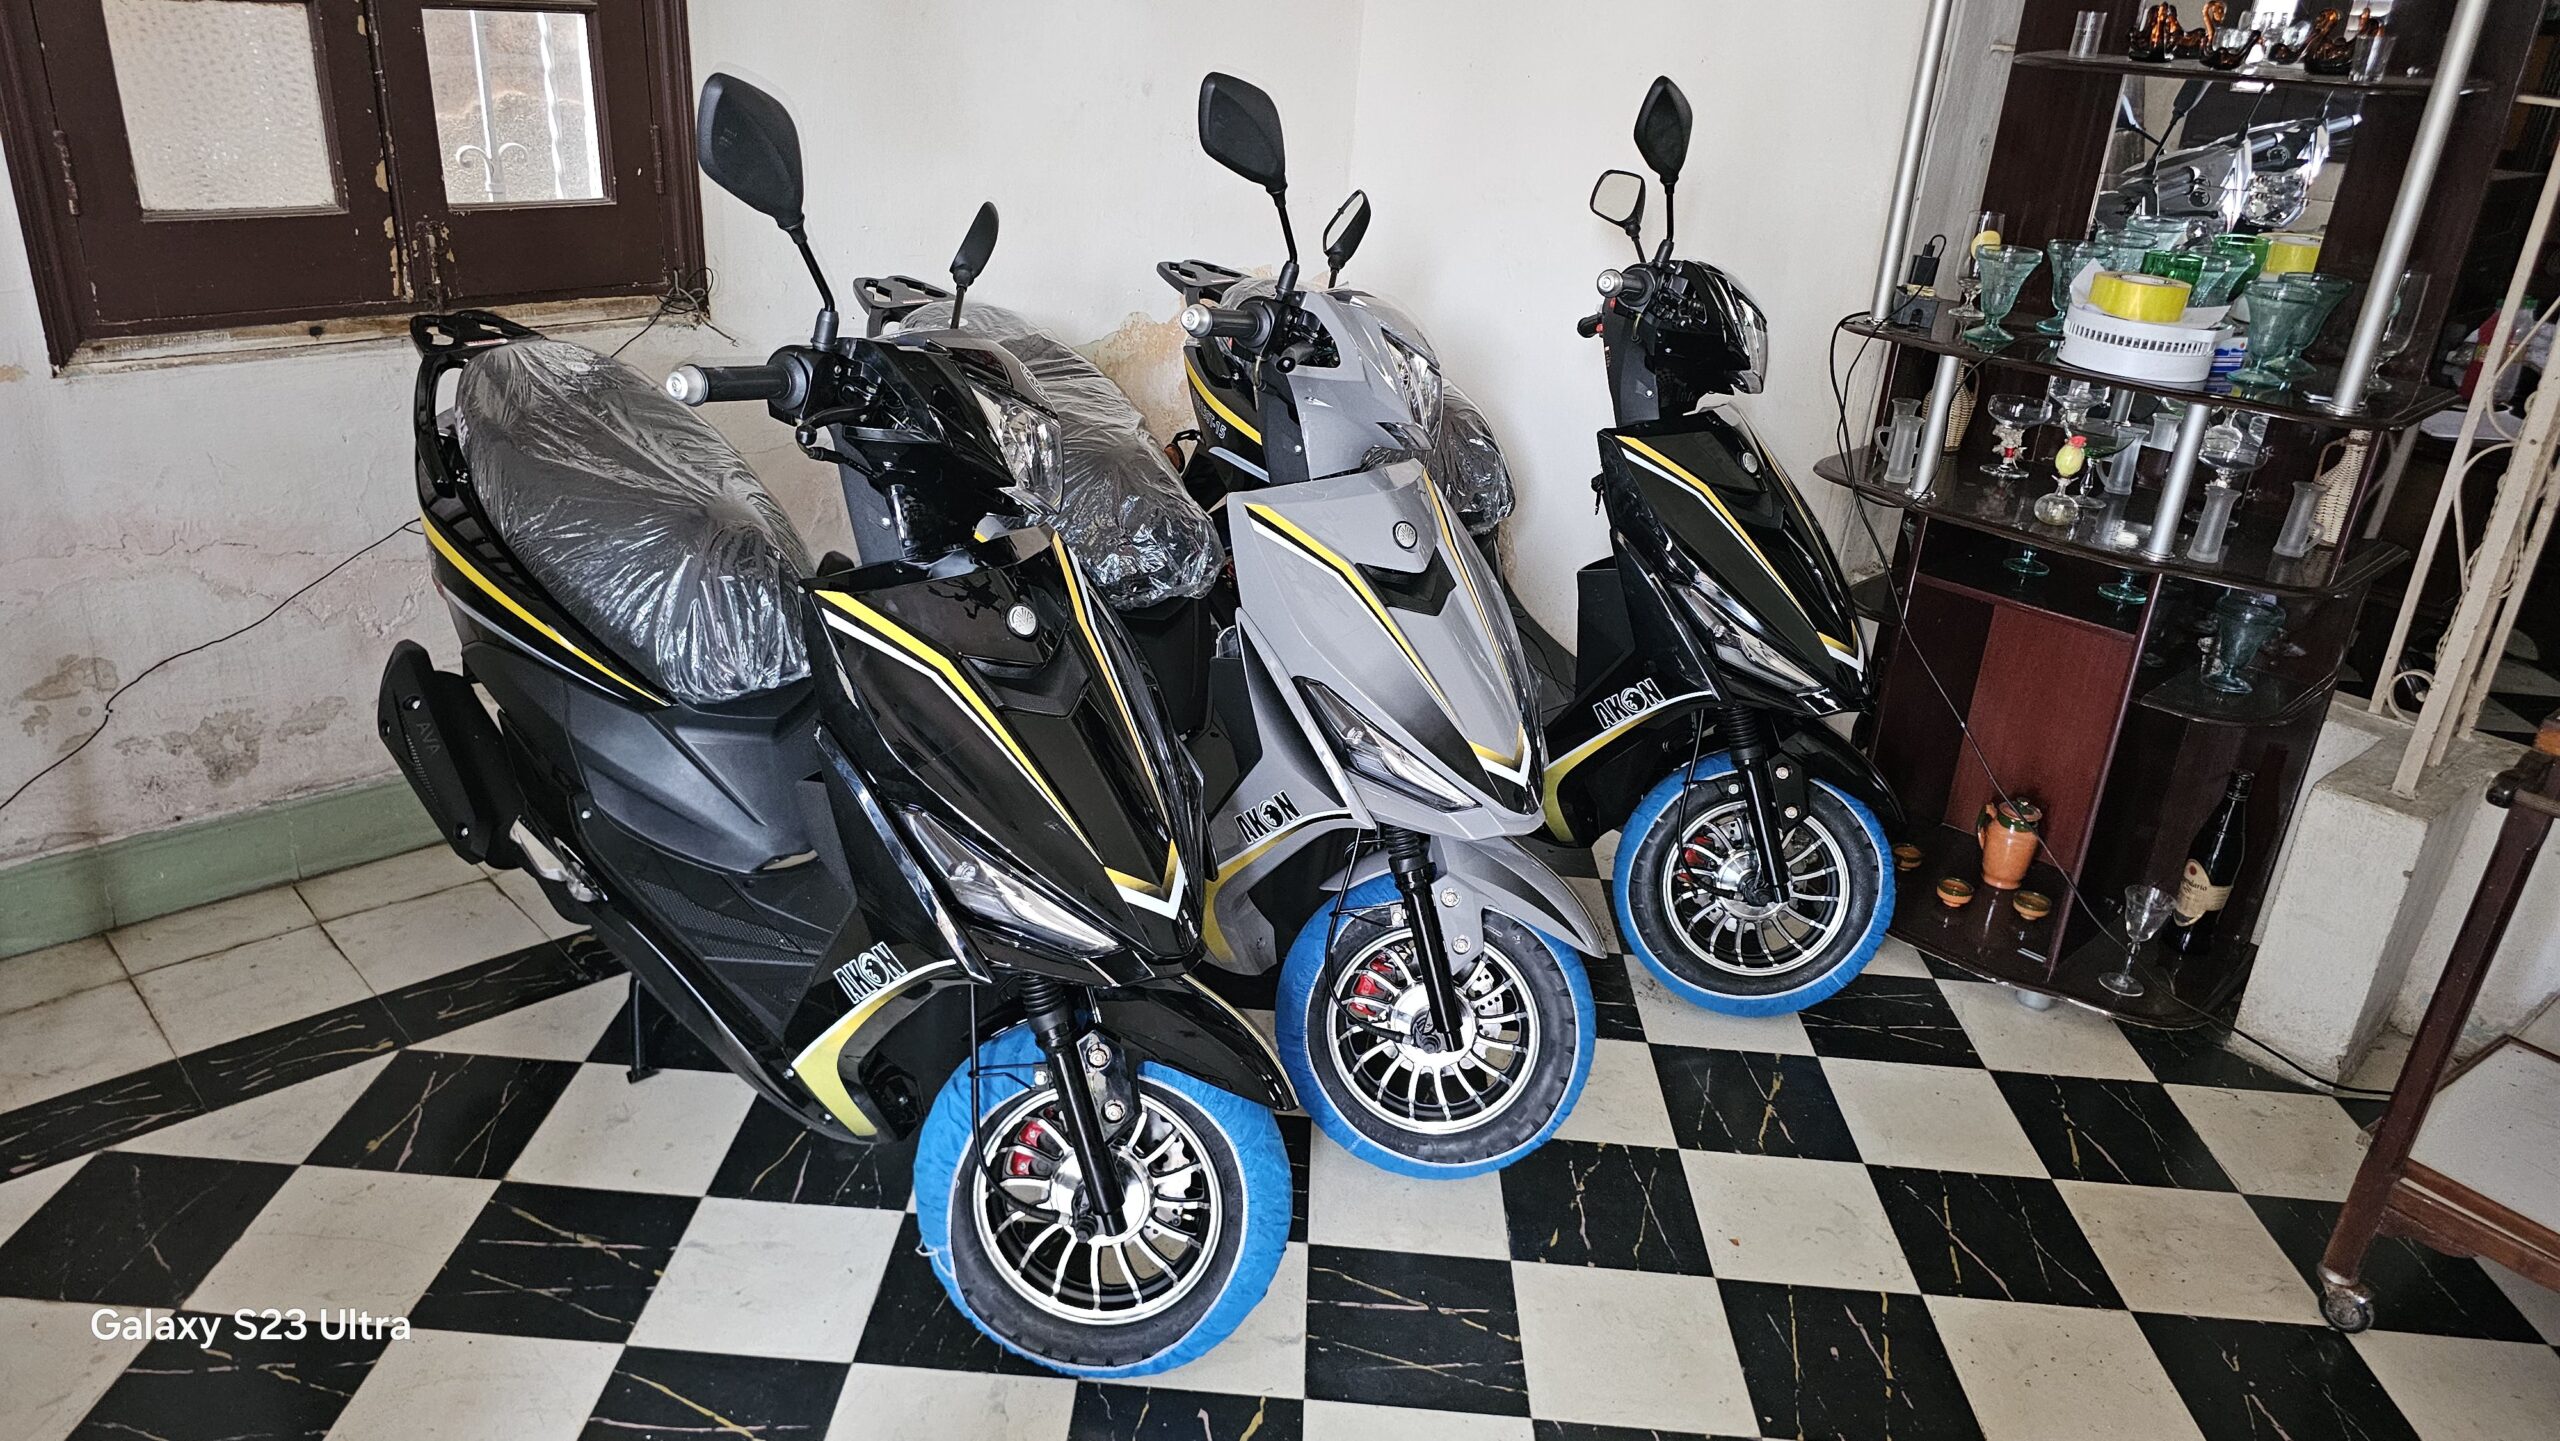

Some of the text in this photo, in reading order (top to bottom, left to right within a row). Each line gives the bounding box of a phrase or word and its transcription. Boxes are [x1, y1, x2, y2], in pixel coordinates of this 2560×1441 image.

[1592, 677, 1666, 730] AKON
[416, 722, 441, 757] AVA
[1234, 789, 1302, 845] AKON
[832, 940, 908, 1005] AKON
